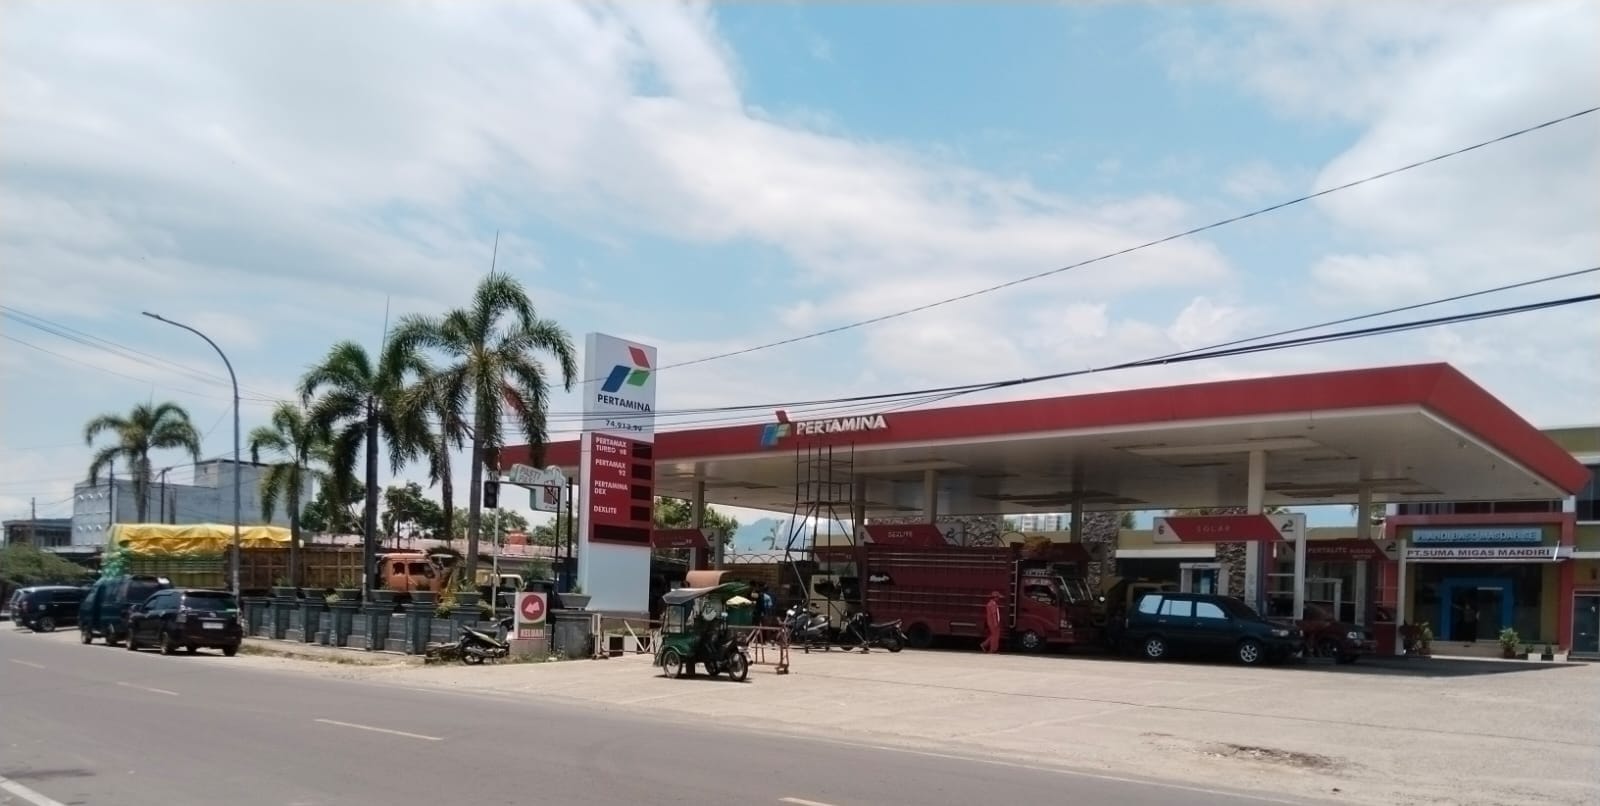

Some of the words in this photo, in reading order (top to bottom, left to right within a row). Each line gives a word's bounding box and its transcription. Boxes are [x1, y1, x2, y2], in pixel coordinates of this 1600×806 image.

[597, 394, 651, 412] PERTAMINA
[796, 415, 887, 435] PERTAMINA
[595, 437, 627, 448] PERTAMAX
[595, 445, 616, 453] TURBO
[595, 459, 626, 469] PERTAMAX
[594, 480, 628, 490] PERTAMINA
[593, 505, 617, 514] DEXLITE
[1458, 549, 1495, 557] MIGAS
